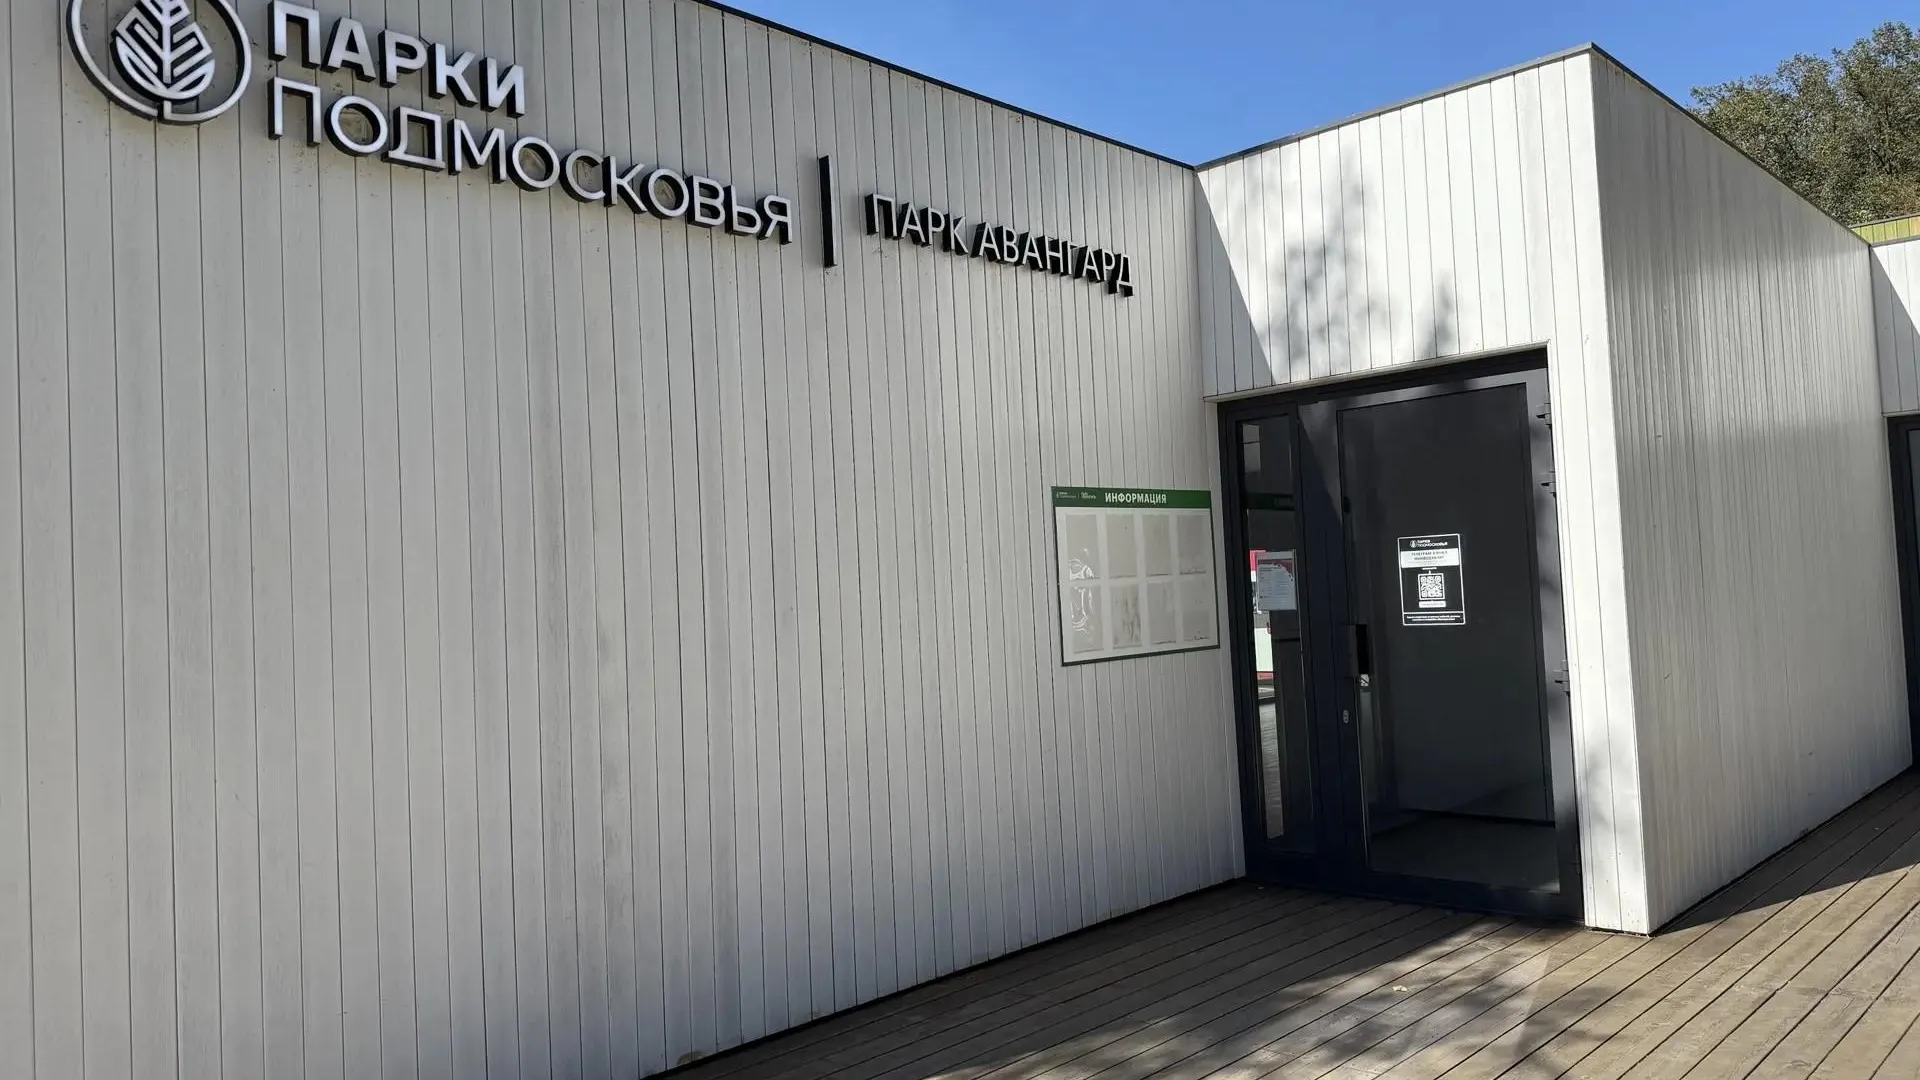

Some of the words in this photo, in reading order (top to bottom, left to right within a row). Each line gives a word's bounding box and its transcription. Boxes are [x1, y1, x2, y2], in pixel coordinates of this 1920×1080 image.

[268, 0, 525, 118] ПАРКИ
[268, 76, 793, 245] ПОДМОСКОВЬЯ
[865, 193, 969, 257] ПАРК
[971, 221, 1135, 297] АВАНГАРД
[1105, 492, 1167, 504] ИНФОРМАЦИЯ
